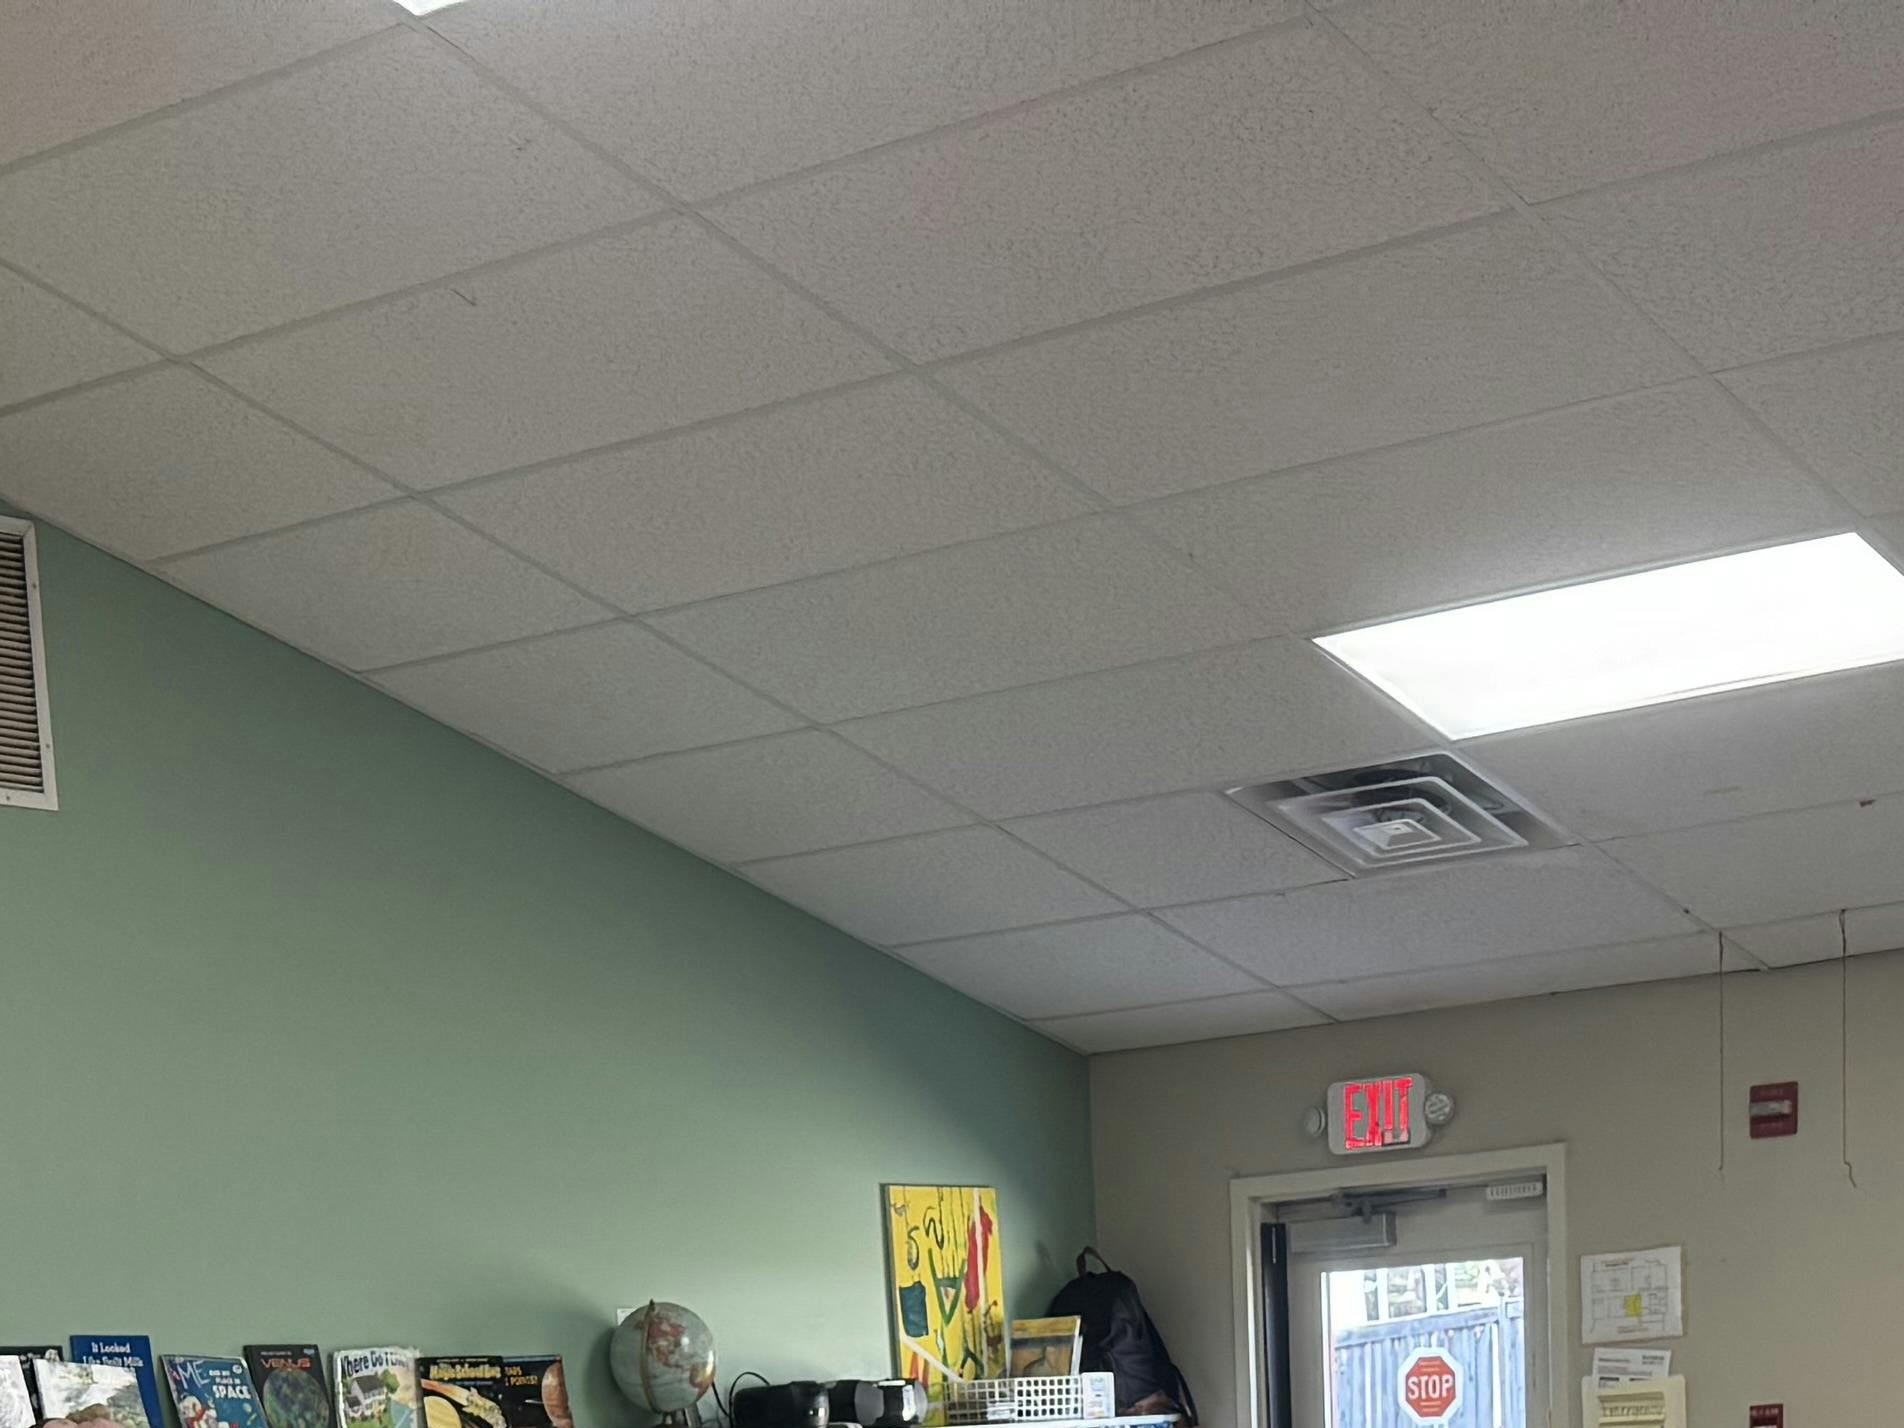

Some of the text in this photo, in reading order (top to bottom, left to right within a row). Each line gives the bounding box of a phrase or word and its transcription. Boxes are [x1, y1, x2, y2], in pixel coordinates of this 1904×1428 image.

[1343, 1076, 1413, 1150] EXIT
[259, 1356, 312, 1371] VENUS
[211, 1385, 252, 1400] SPACE
[1406, 1373, 1454, 1401] STOP
